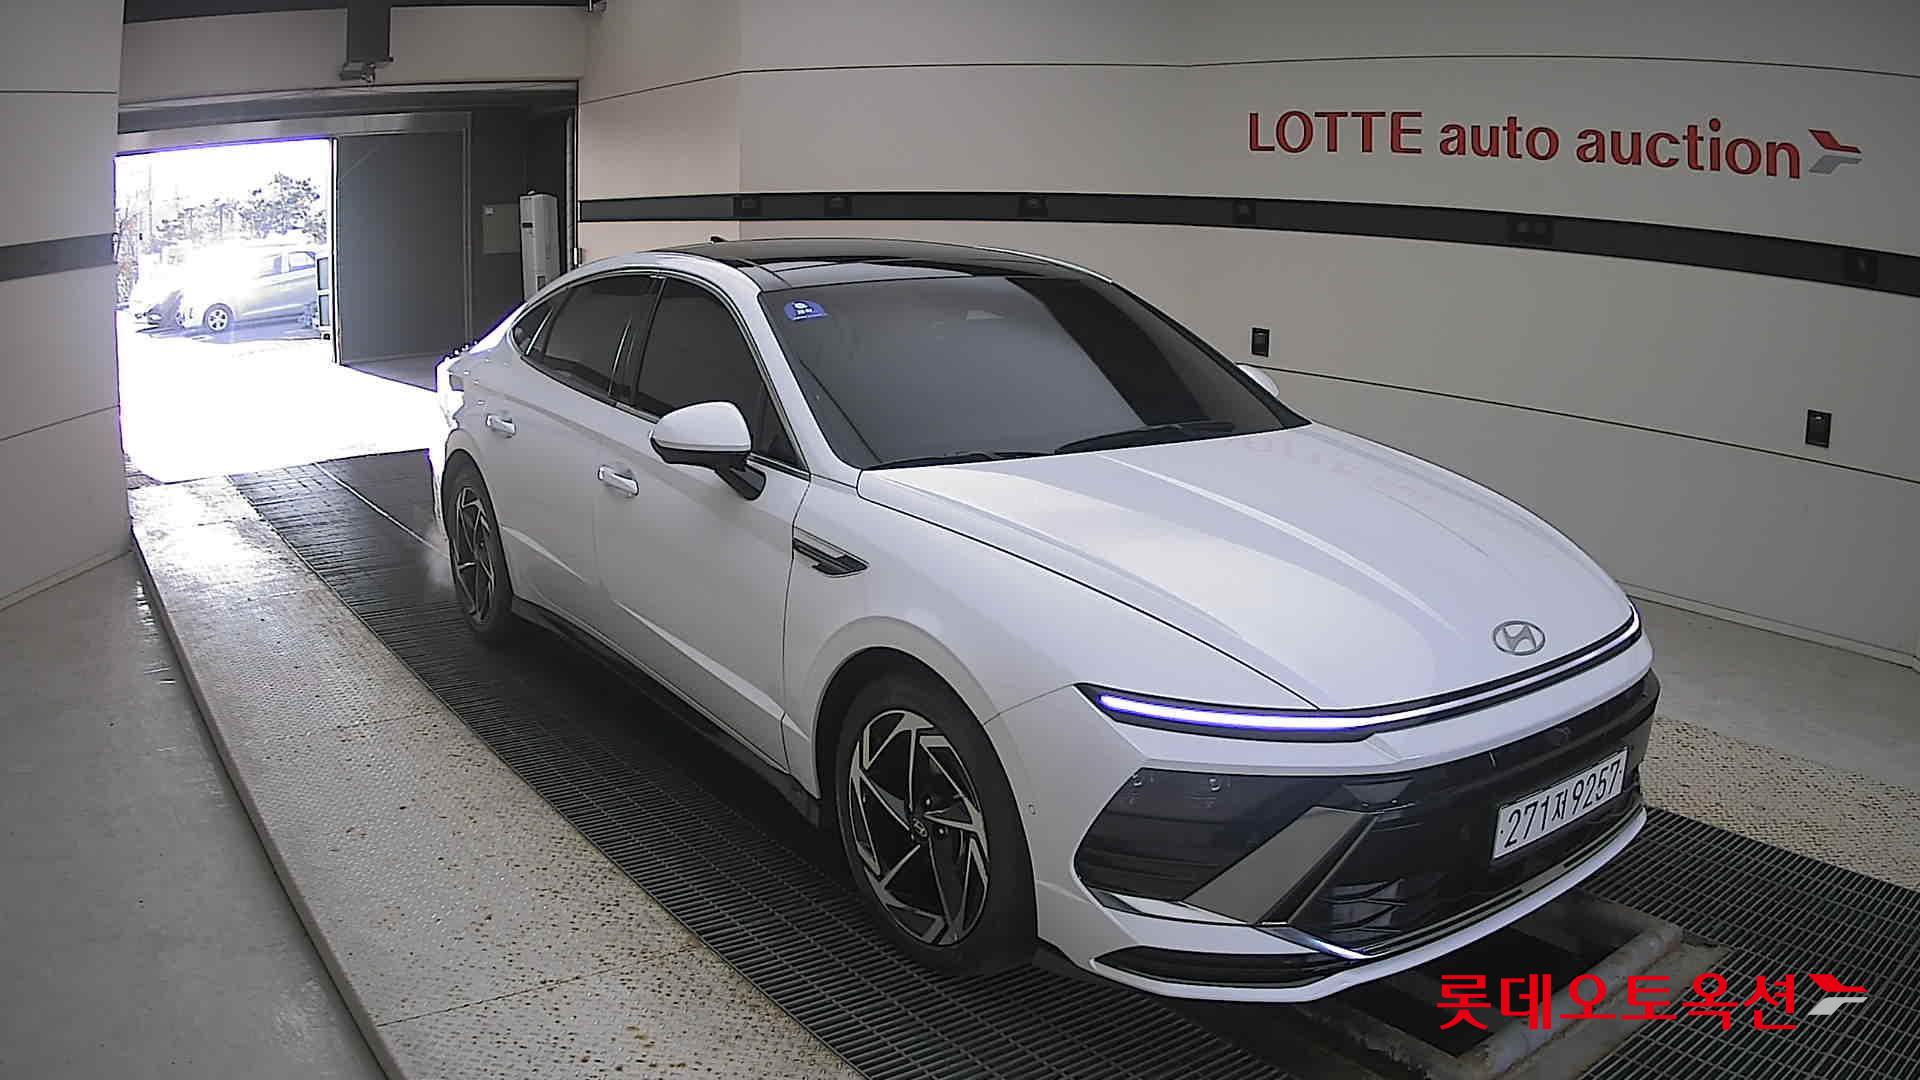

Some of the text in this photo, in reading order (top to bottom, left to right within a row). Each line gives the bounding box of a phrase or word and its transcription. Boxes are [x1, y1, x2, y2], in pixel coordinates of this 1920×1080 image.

[1250, 110, 1800, 178] LOTTE auto auction
